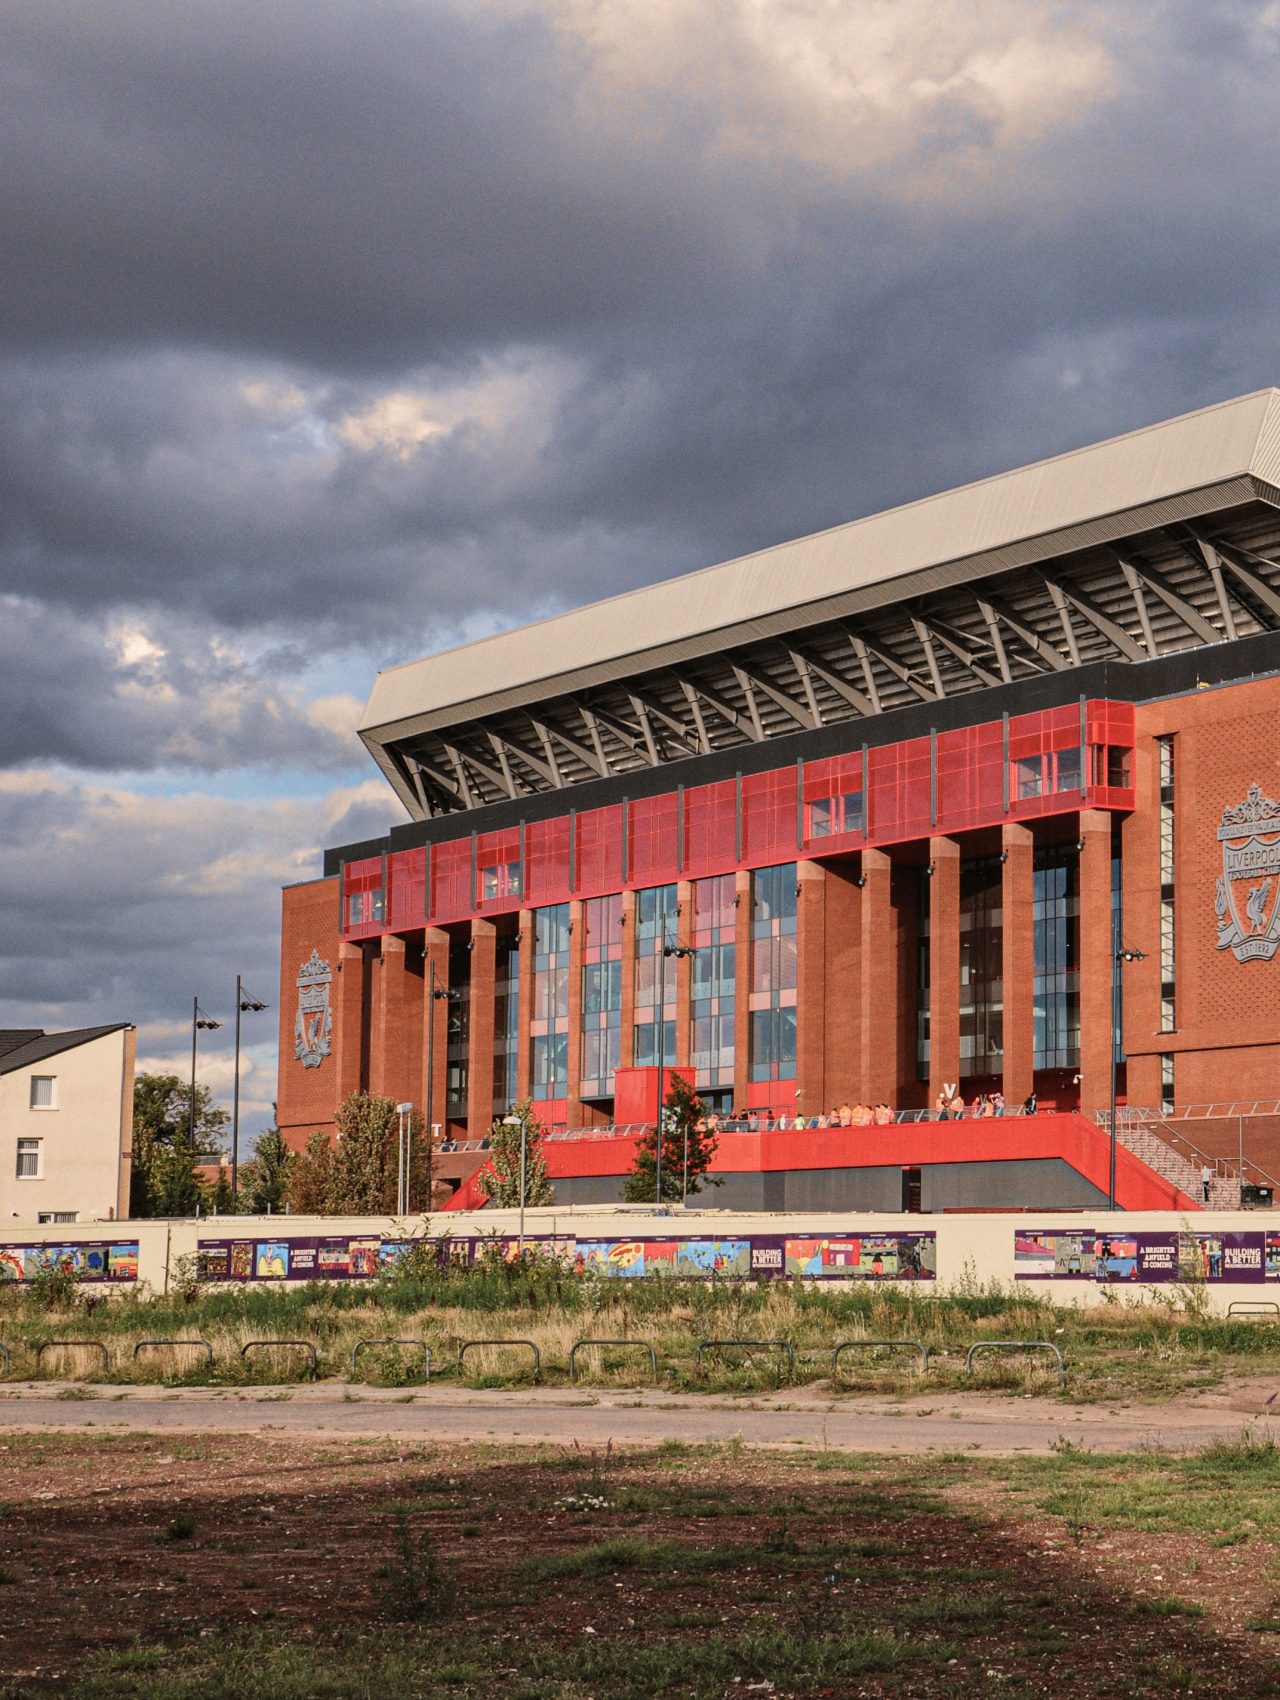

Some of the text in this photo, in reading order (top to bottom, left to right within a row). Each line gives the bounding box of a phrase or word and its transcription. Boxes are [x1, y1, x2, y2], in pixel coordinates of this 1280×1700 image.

[1227, 848, 1280, 868] LIVERPOOL
[943, 1083, 957, 1100] V
[431, 1123, 443, 1136] T
[752, 1249, 782, 1257] BUILDING
[1145, 1246, 1175, 1254] BRIGHTER
[1225, 1248, 1261, 1256] BUILDING
[752, 1256, 782, 1264] A BETTER
[1225, 1256, 1261, 1264] A BETTER
